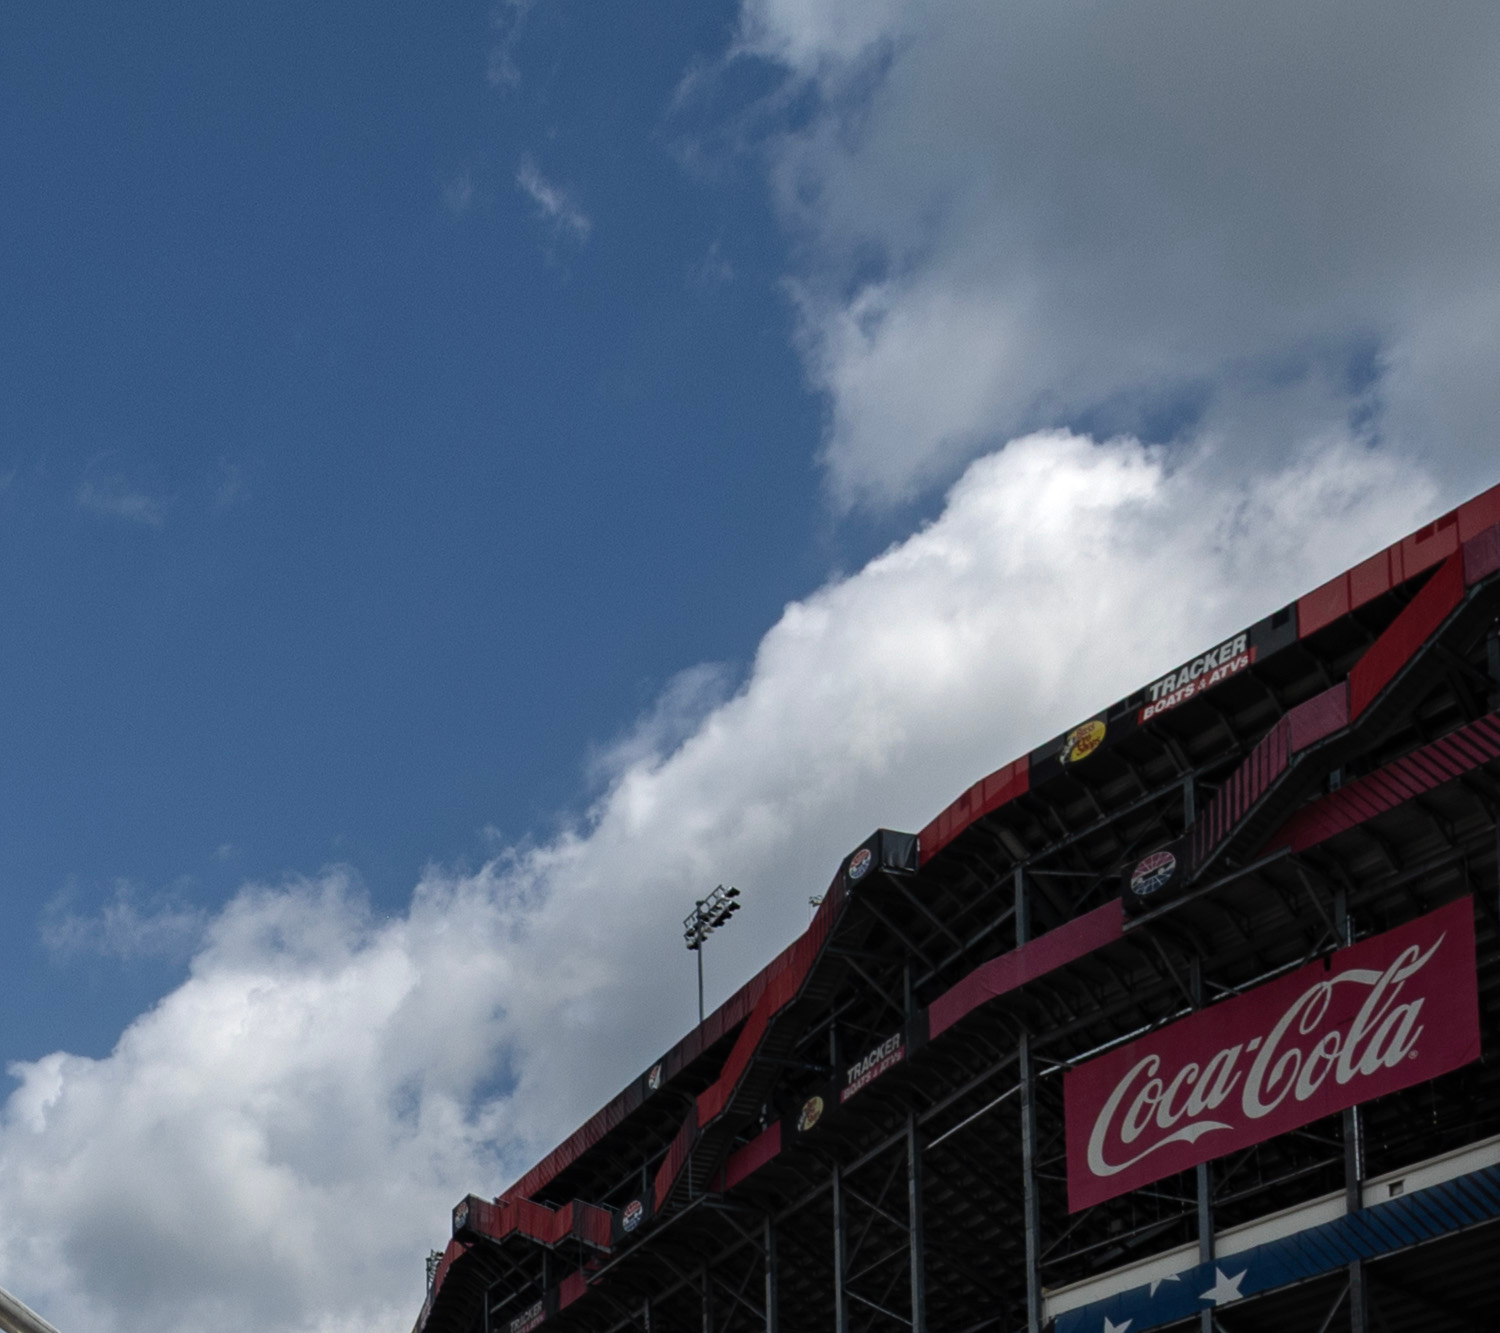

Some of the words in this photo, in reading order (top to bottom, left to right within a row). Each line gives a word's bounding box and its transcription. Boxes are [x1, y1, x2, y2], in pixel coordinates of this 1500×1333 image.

[1150, 634, 1247, 702] TRACKER
[1143, 683, 1195, 721] BOATS
[847, 1033, 900, 1084] TRACKER
[1087, 930, 1447, 1177] Coca-Cola
